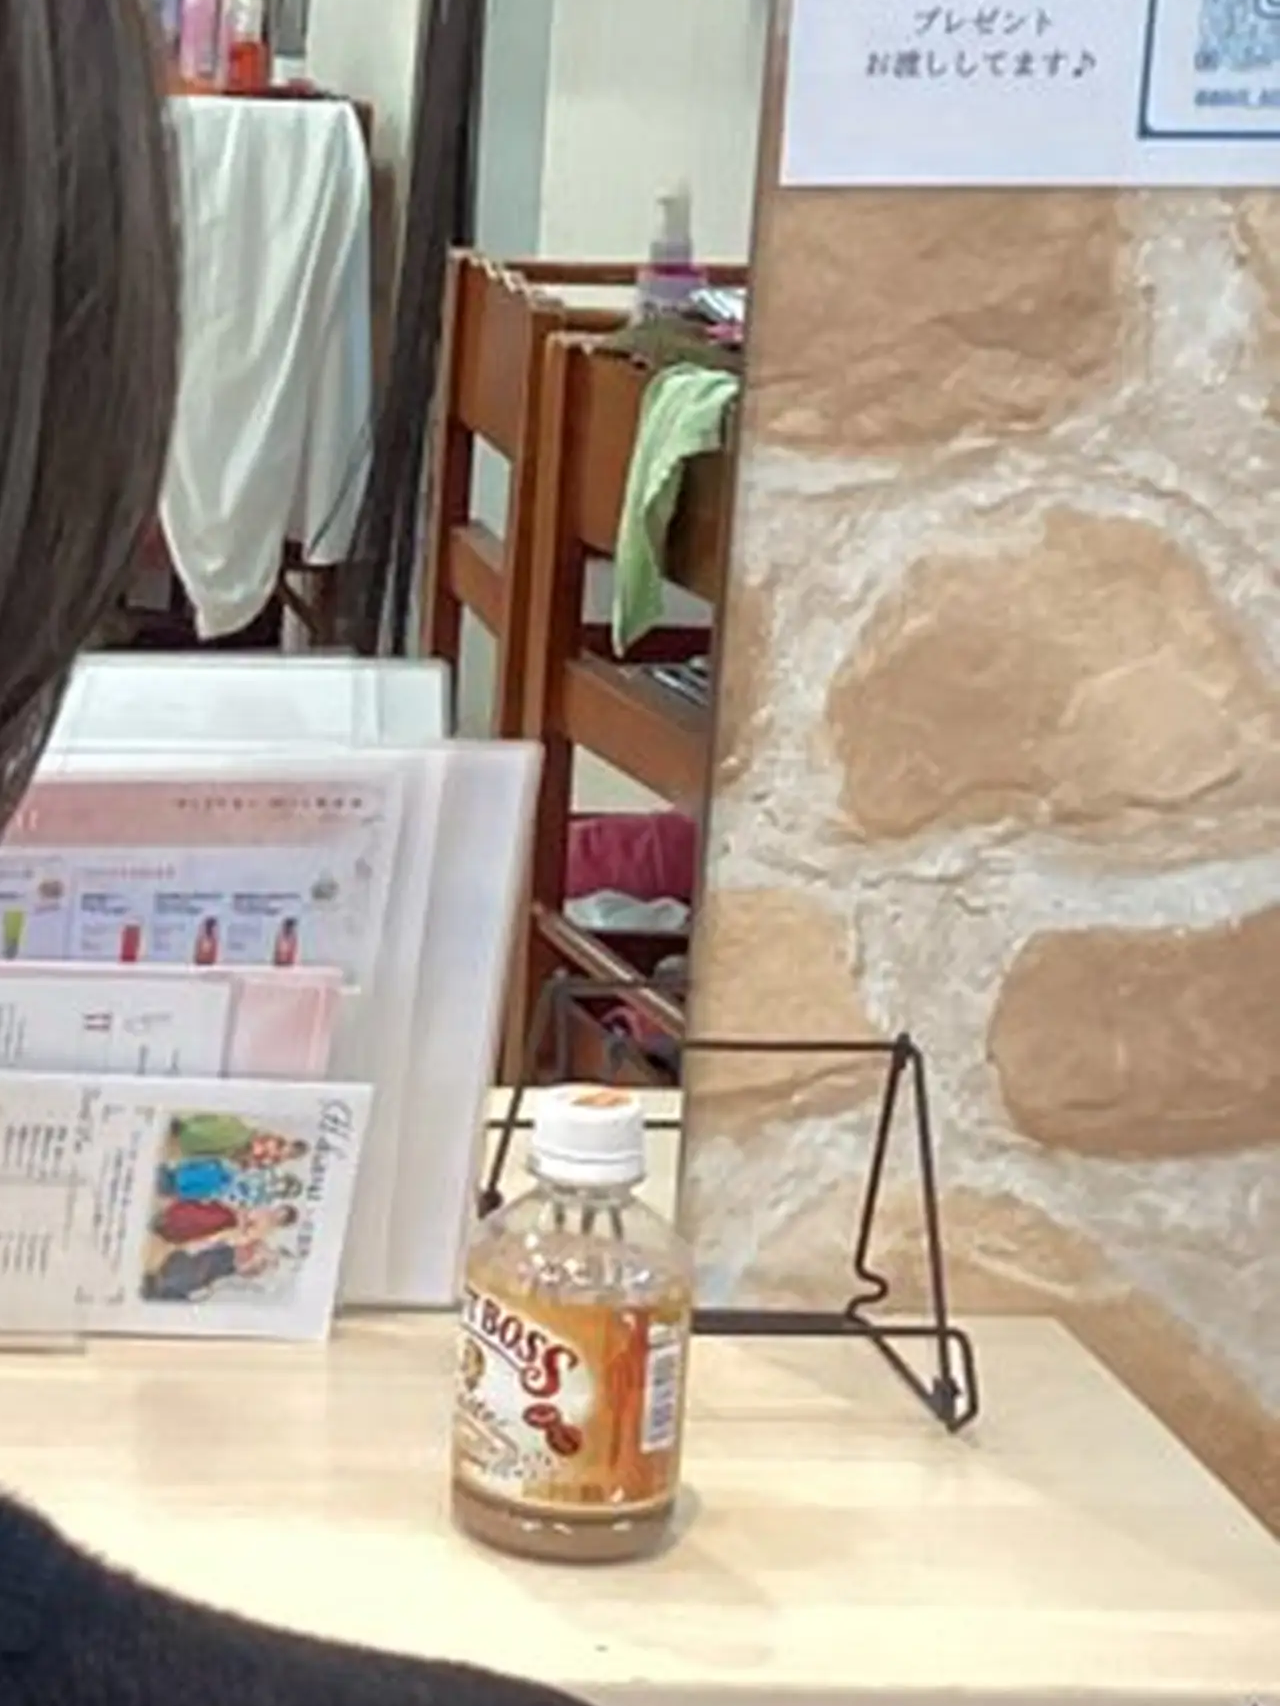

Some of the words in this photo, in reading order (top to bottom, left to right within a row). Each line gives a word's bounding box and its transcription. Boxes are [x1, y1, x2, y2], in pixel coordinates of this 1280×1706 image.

[912, 5, 1053, 37] プレゼント
[481, 1297, 579, 1398] BOSS
